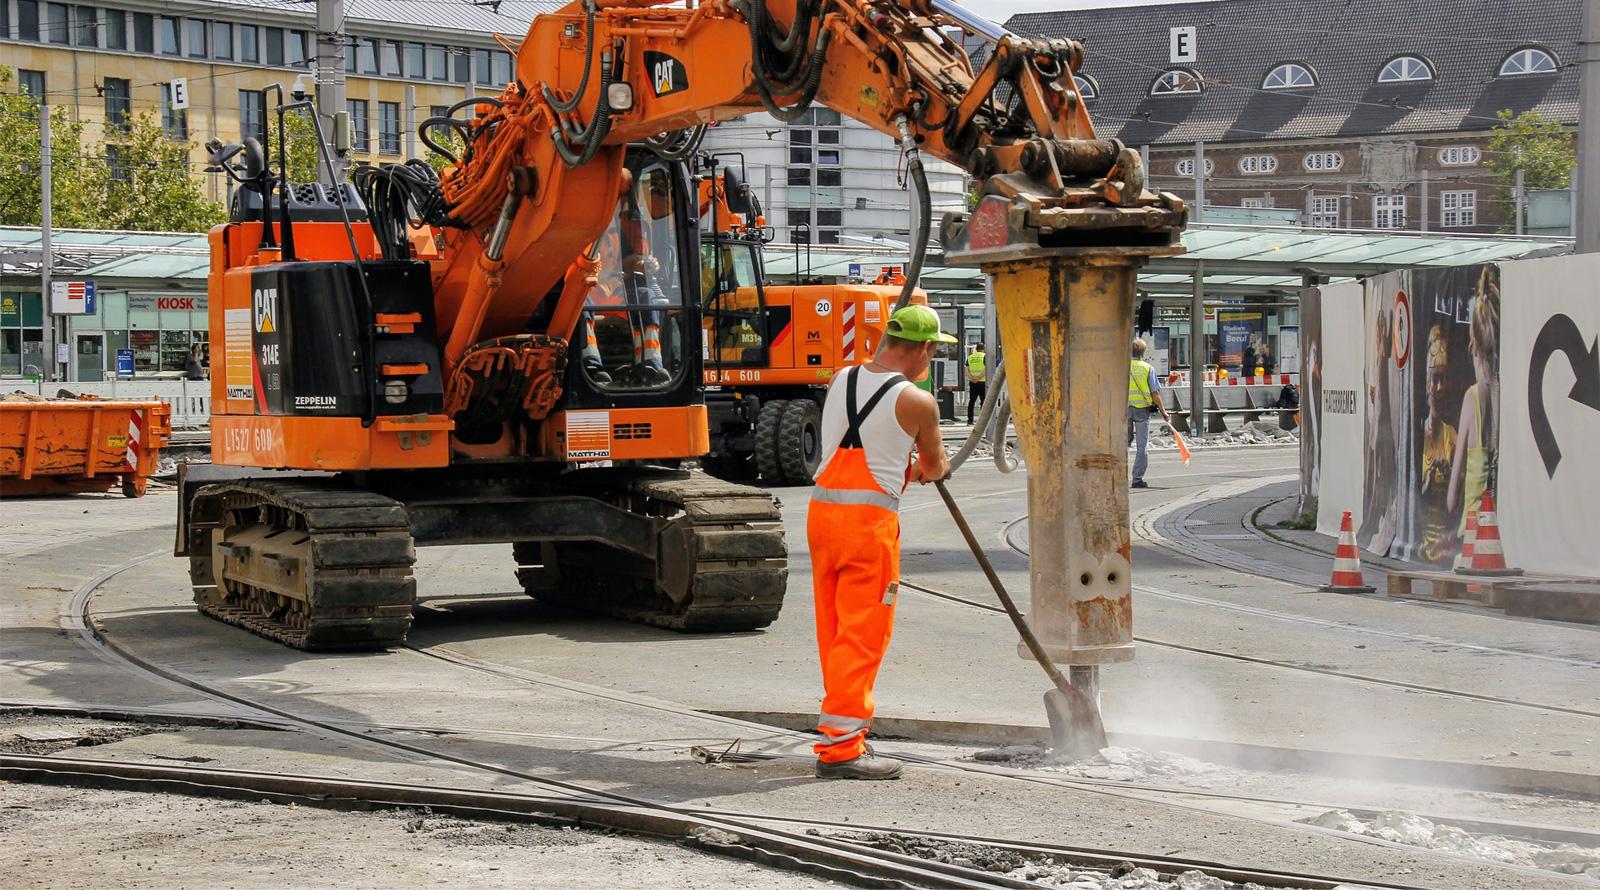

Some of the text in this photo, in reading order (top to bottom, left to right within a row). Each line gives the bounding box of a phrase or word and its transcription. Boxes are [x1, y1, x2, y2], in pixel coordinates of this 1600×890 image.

[1178, 34, 1189, 56] E
[654, 58, 674, 95] CAT
[176, 84, 184, 104] E
[158, 298, 194, 310] KIOSK
[254, 288, 277, 333] CAT
[817, 302, 830, 312] 20
[262, 344, 280, 366] 314E
[740, 370, 760, 381] 600
[295, 396, 336, 405] ZEPPELIN
[254, 429, 272, 450] 600
